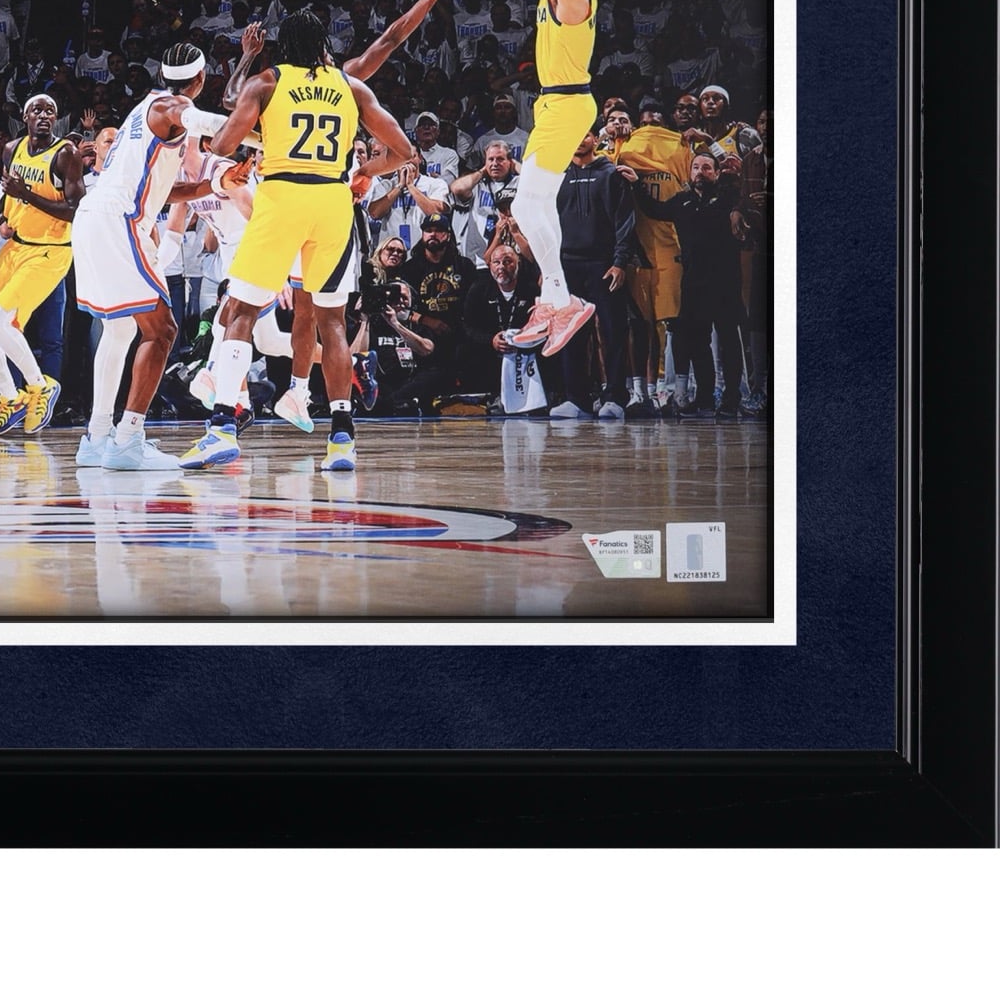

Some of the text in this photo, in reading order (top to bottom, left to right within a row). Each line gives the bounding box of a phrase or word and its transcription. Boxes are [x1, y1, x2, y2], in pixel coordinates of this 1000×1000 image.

[288, 86, 343, 107] NESMITH
[288, 112, 342, 162] 23
[599, 540, 628, 548] Fanatics
